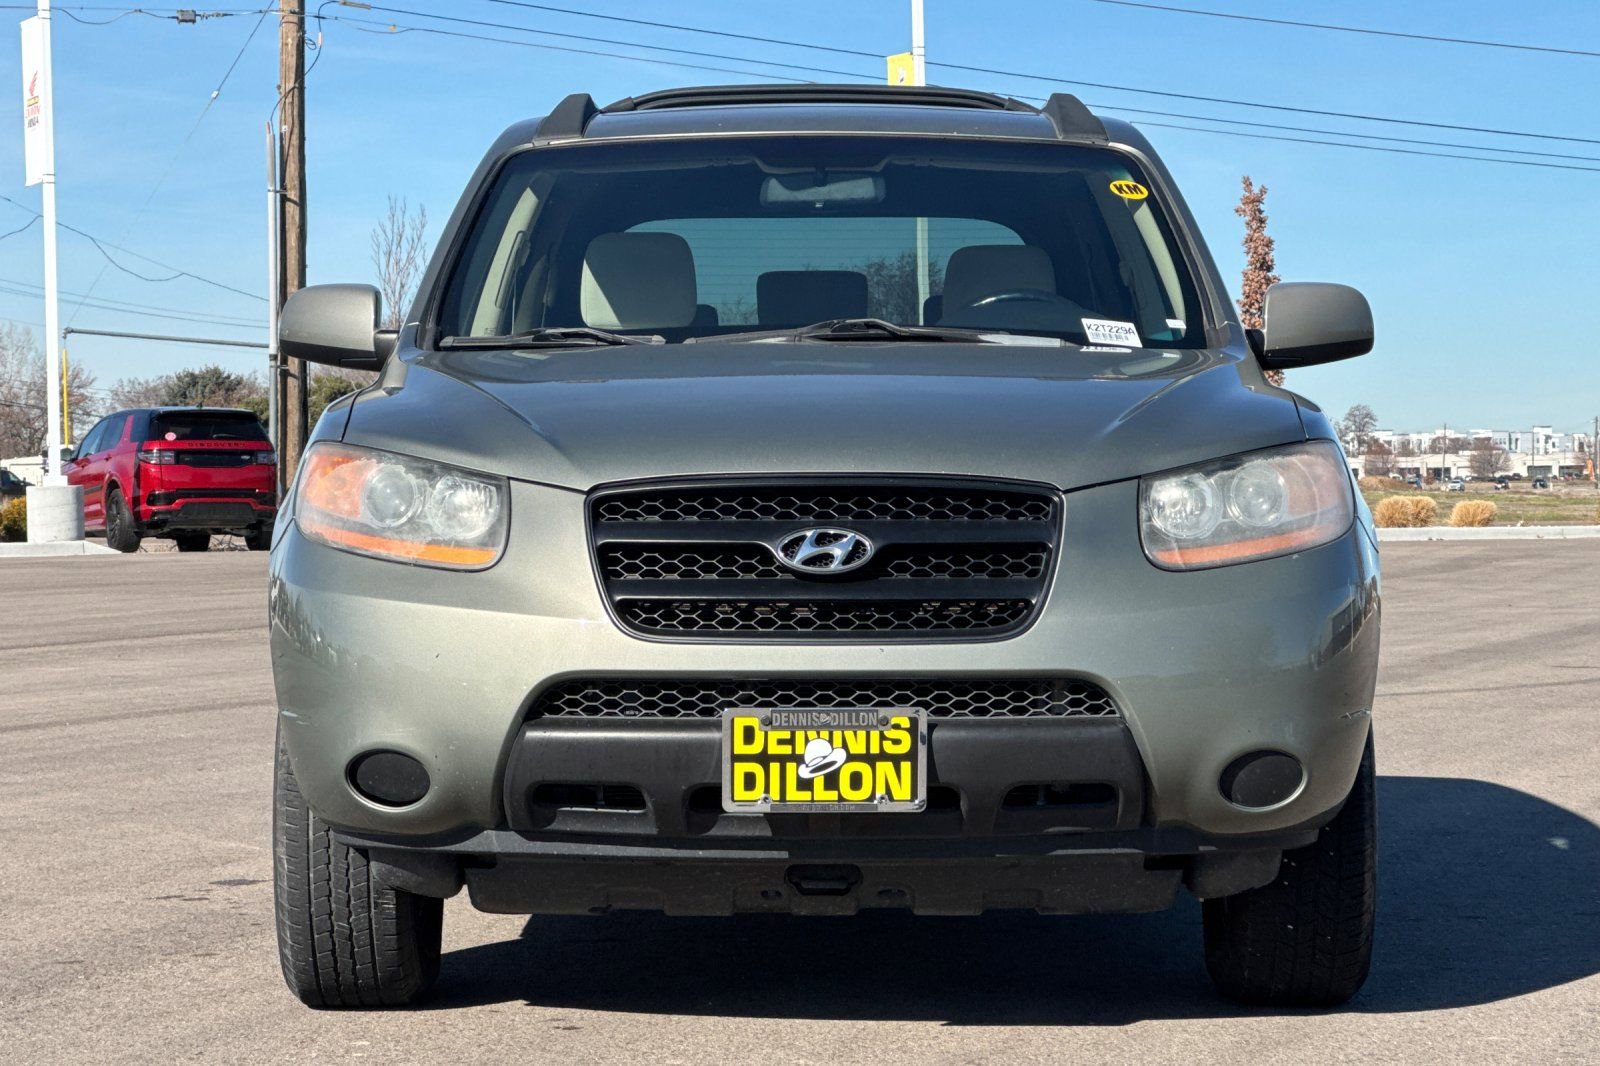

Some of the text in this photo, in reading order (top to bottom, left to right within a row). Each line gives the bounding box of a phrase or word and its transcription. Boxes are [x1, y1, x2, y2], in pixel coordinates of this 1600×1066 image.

[1112, 183, 1144, 195] KM
[1085, 322, 1136, 336] K2T229A
[772, 711, 878, 727] DENNIS DILLON
[733, 761, 912, 801] DILLON
